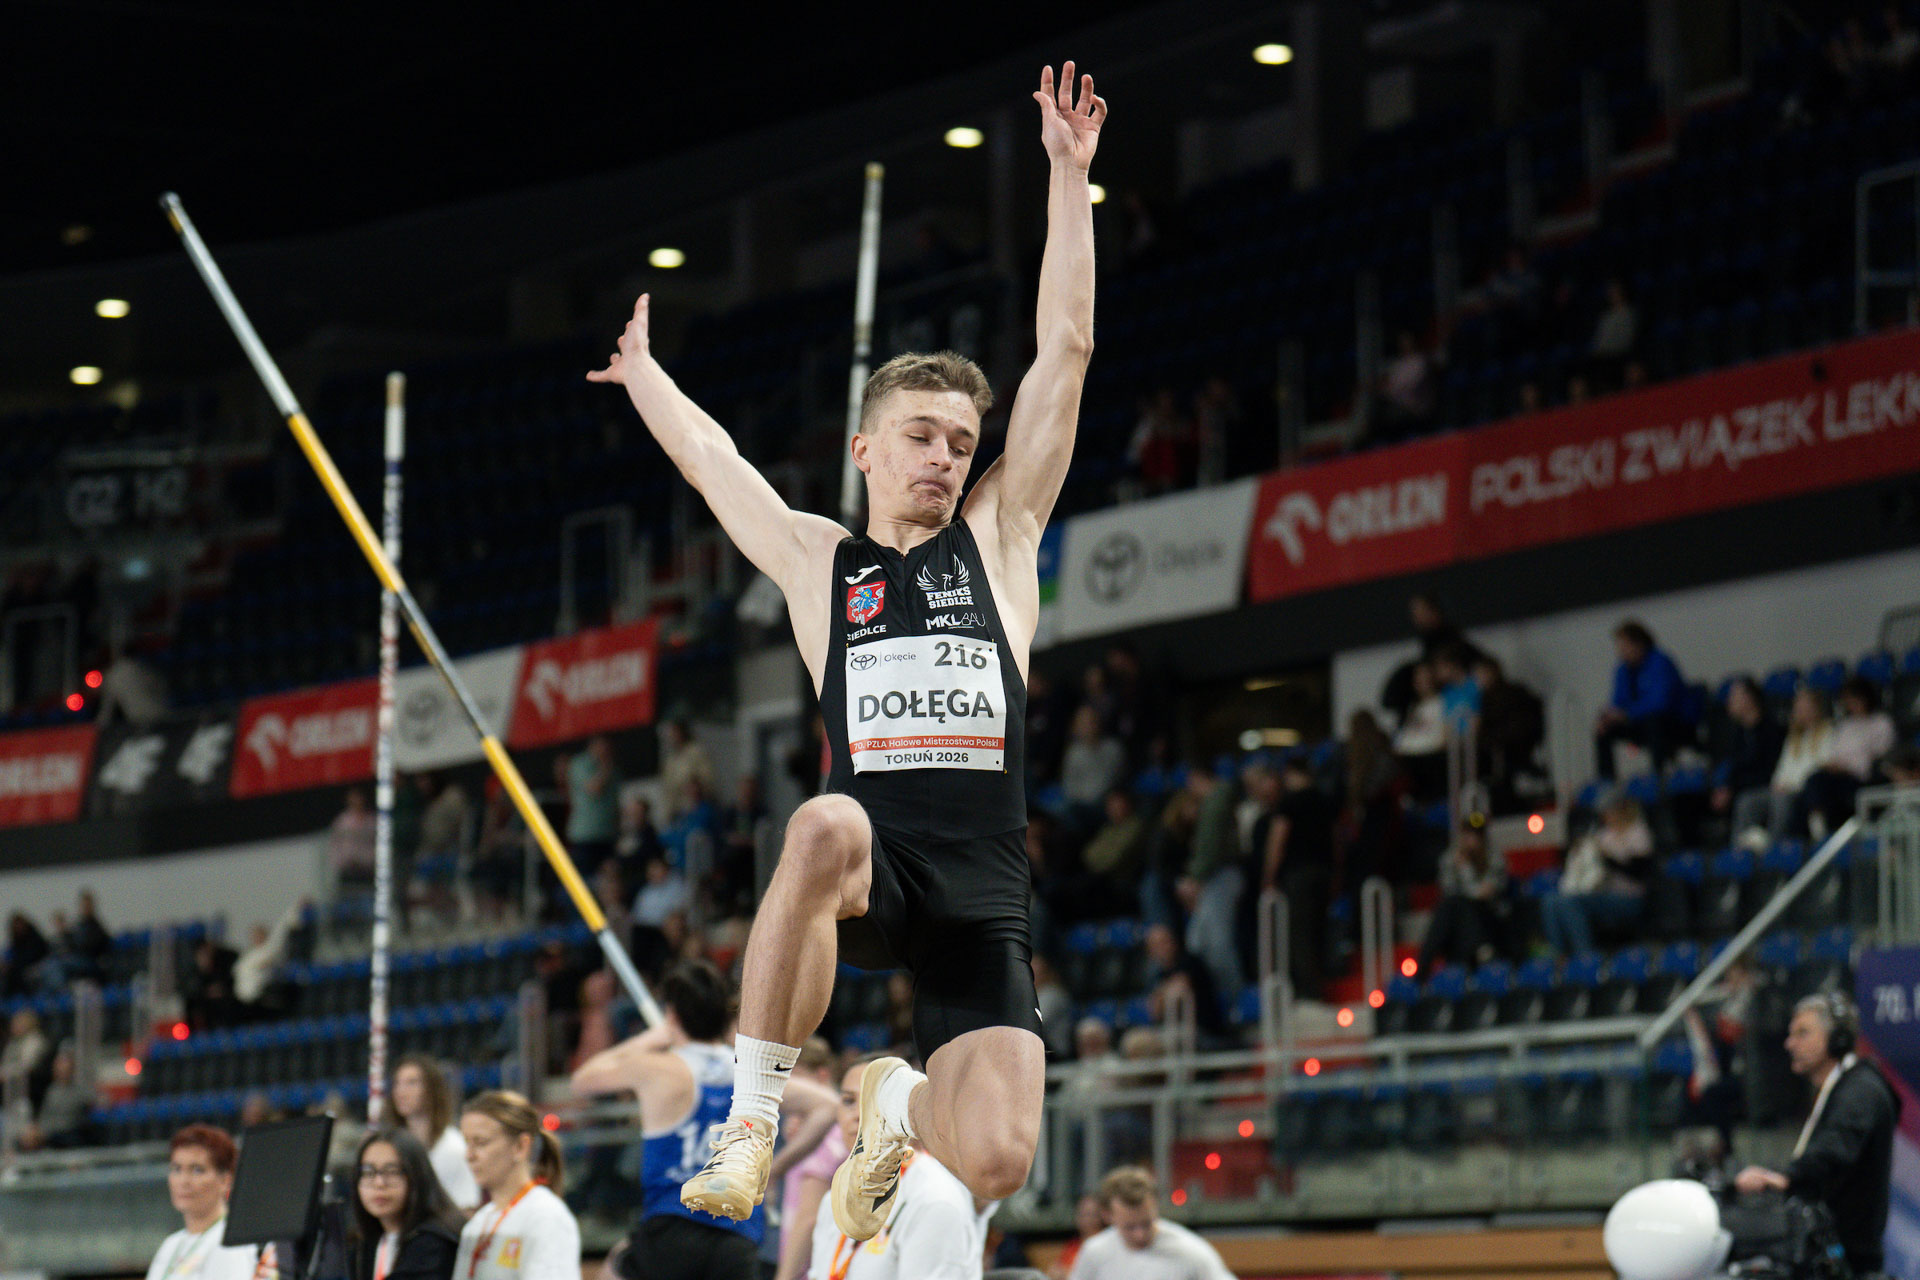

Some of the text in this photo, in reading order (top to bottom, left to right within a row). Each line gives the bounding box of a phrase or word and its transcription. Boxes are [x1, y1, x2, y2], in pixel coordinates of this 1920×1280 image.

[1470, 437, 1616, 514] POLSKI
[1327, 473, 1449, 546] ORLEN
[925, 586, 972, 601] FENIKS
[928, 597, 974, 609] SIEDLCE
[884, 652, 917, 662] Okęcie
[934, 642, 987, 670] 216
[858, 689, 994, 724] DOŁĘGA
[867, 740, 887, 748] PZLA
[888, 739, 921, 747] Halowe
[923, 737, 974, 746] Mistrzostwa
[976, 738, 999, 747] Polski
[885, 750, 969, 765] TORUŃ 2026
